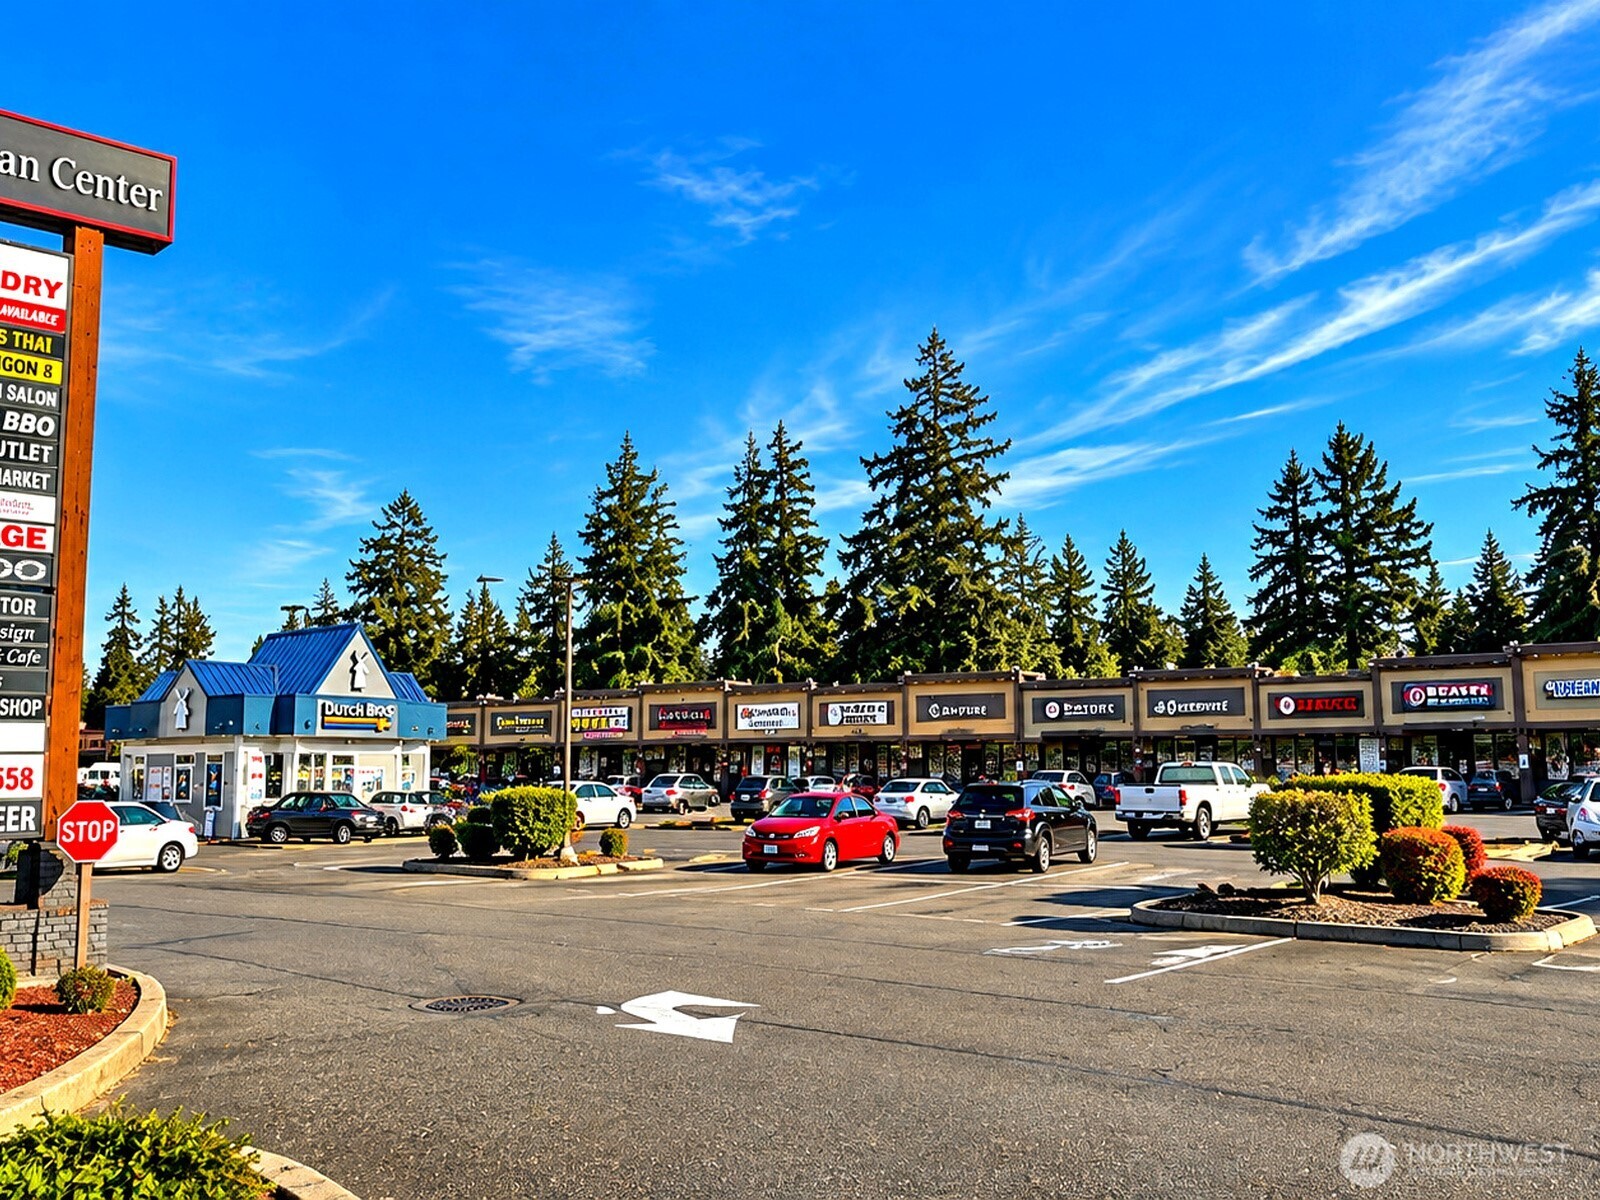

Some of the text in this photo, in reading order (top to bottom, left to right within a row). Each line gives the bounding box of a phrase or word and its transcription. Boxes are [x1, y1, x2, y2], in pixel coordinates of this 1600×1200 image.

[0, 149, 163, 212] an Center
[0, 270, 63, 299] DRY
[0, 304, 59, 326] AVAILABLE
[12, 331, 52, 354] THAI
[43, 364, 53, 378] 8
[6, 384, 57, 407] SALON
[1, 524, 47, 550] GE
[0, 596, 36, 616] TOR
[0, 623, 35, 644] sign
[6, 648, 41, 667] Cafe
[0, 698, 42, 716] SHOP
[61, 819, 115, 843] STOP
